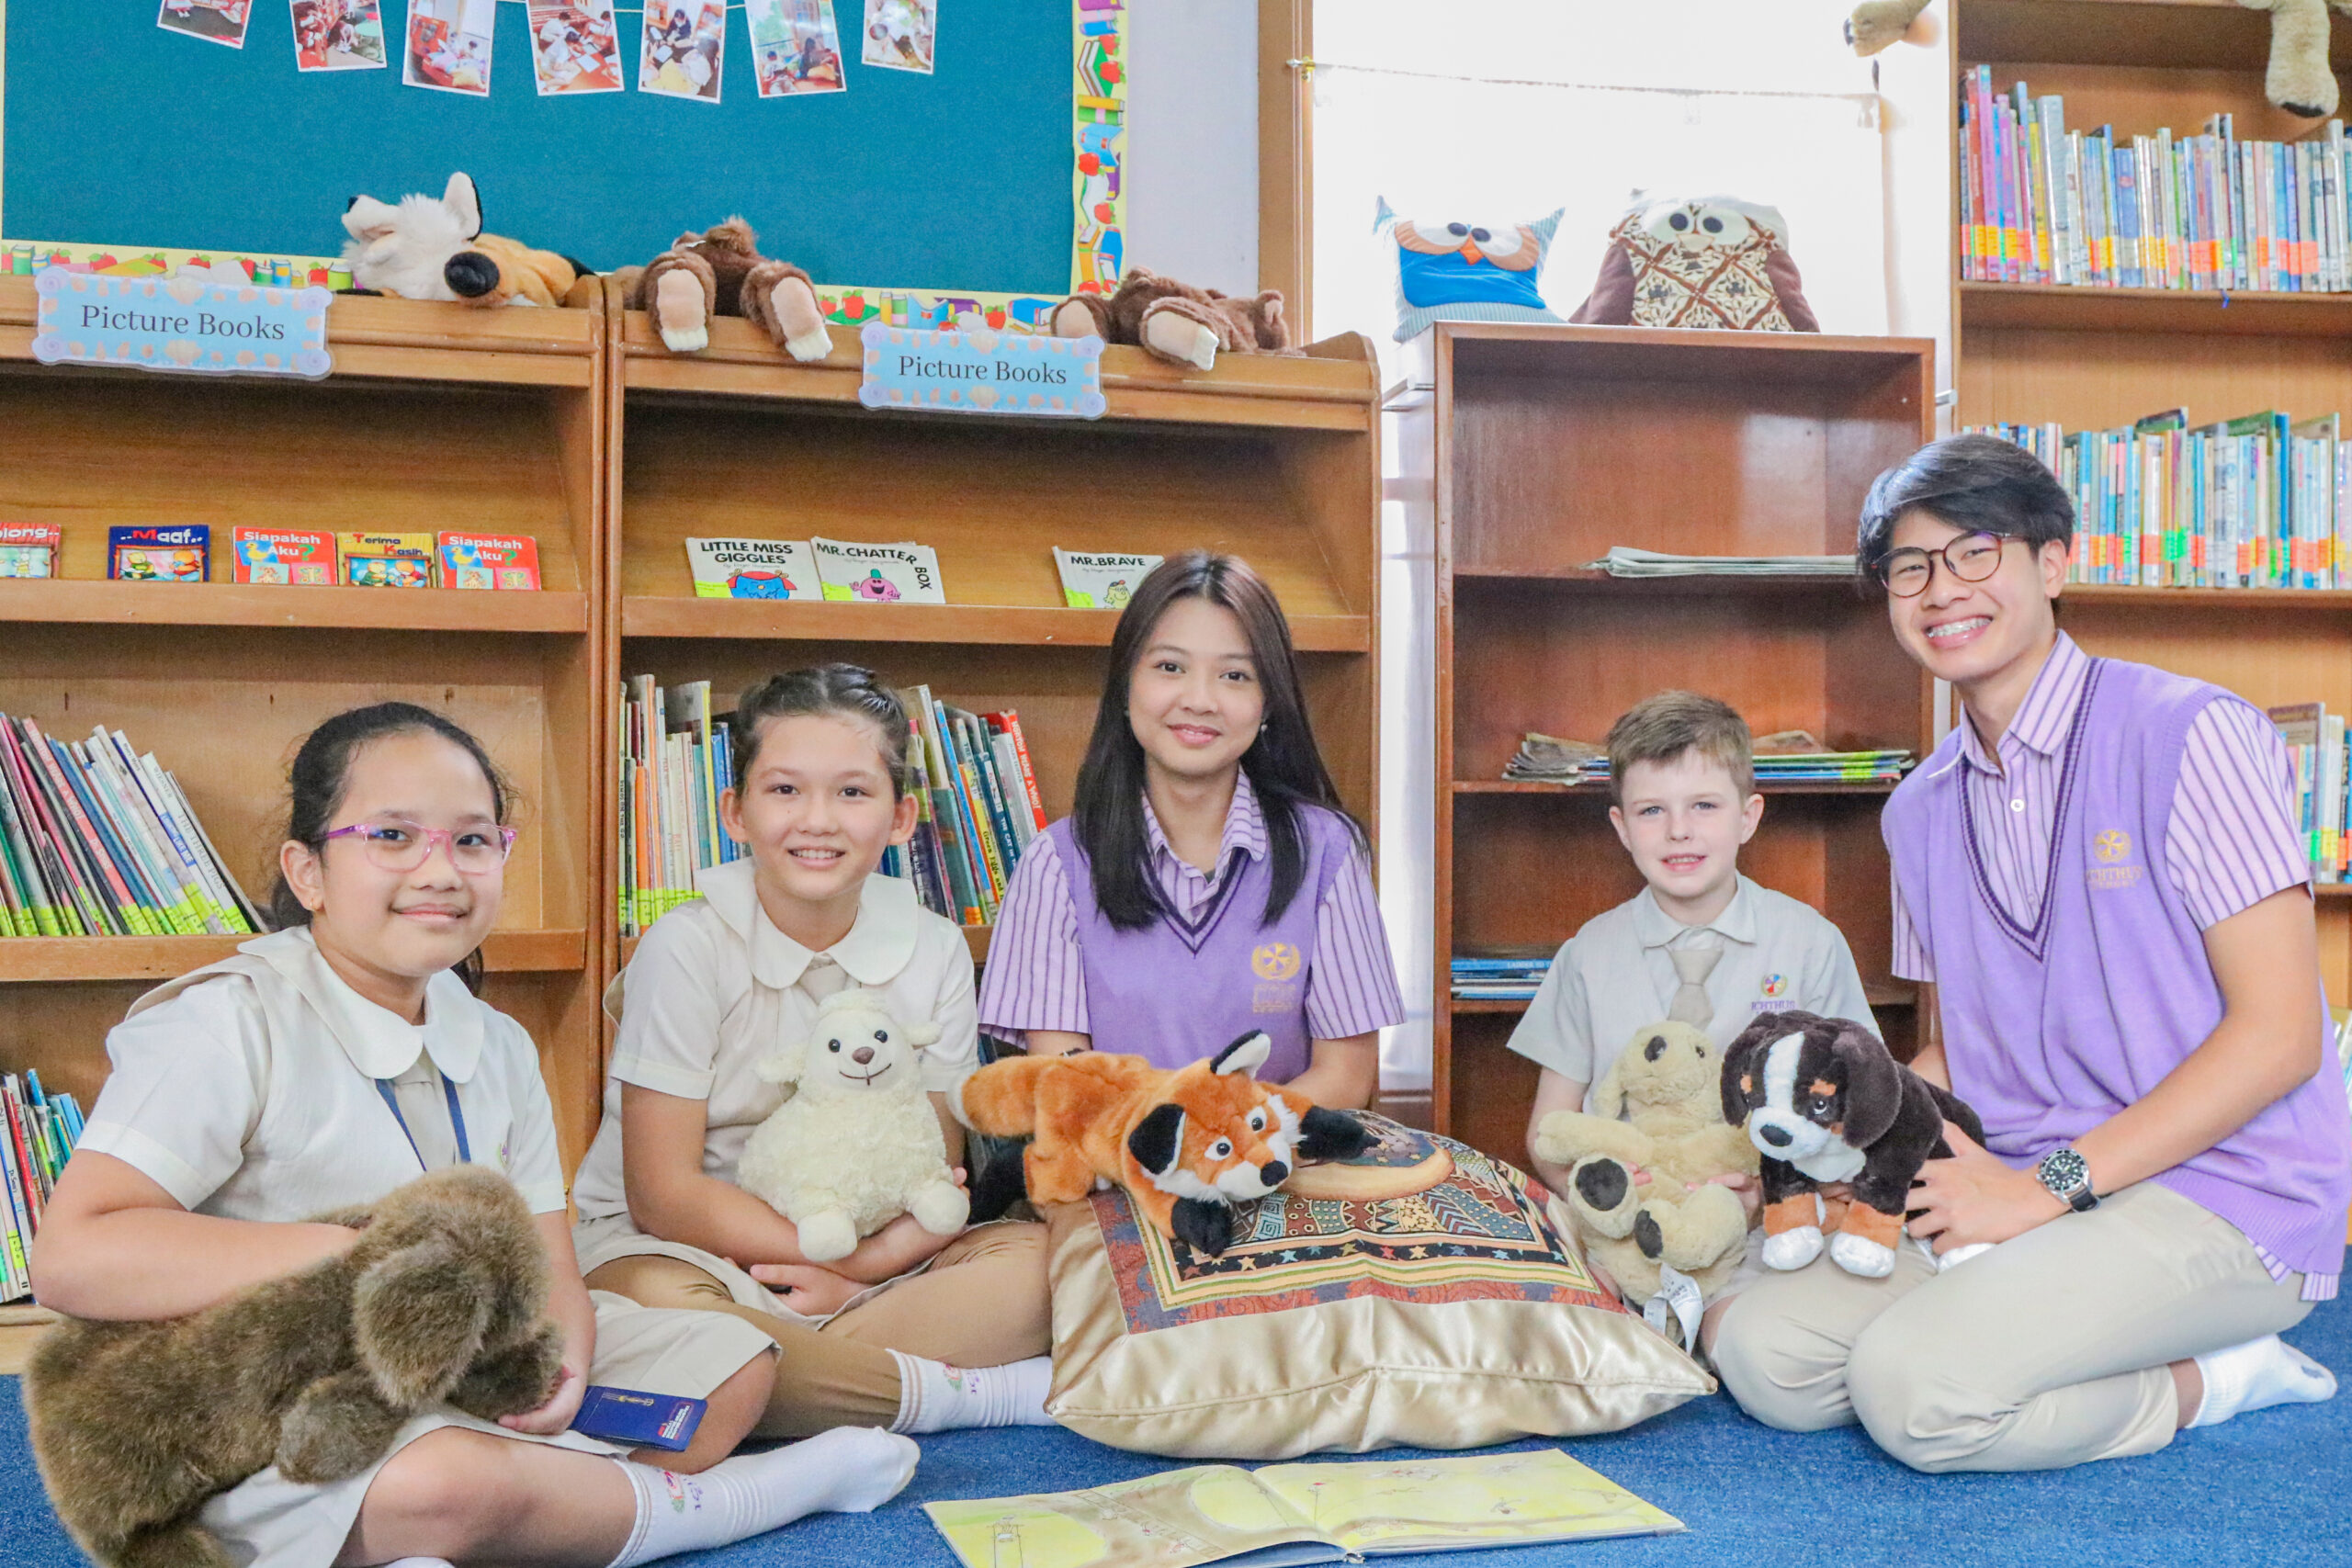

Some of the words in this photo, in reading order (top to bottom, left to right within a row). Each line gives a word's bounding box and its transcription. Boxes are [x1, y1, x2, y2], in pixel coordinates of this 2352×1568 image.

[81, 304, 189, 333] Picture
[198, 312, 286, 340] Books
[899, 355, 988, 380] Picture
[995, 360, 1067, 384] Books
[243, 531, 321, 544] Siapakah
[448, 536, 523, 549] Siapakah
[700, 541, 750, 552] LITTLE
[753, 543, 794, 554] MISS
[715, 553, 786, 564] GIGGLES
[914, 567, 933, 590] BOX
[1004, 833, 1012, 847] CAT
